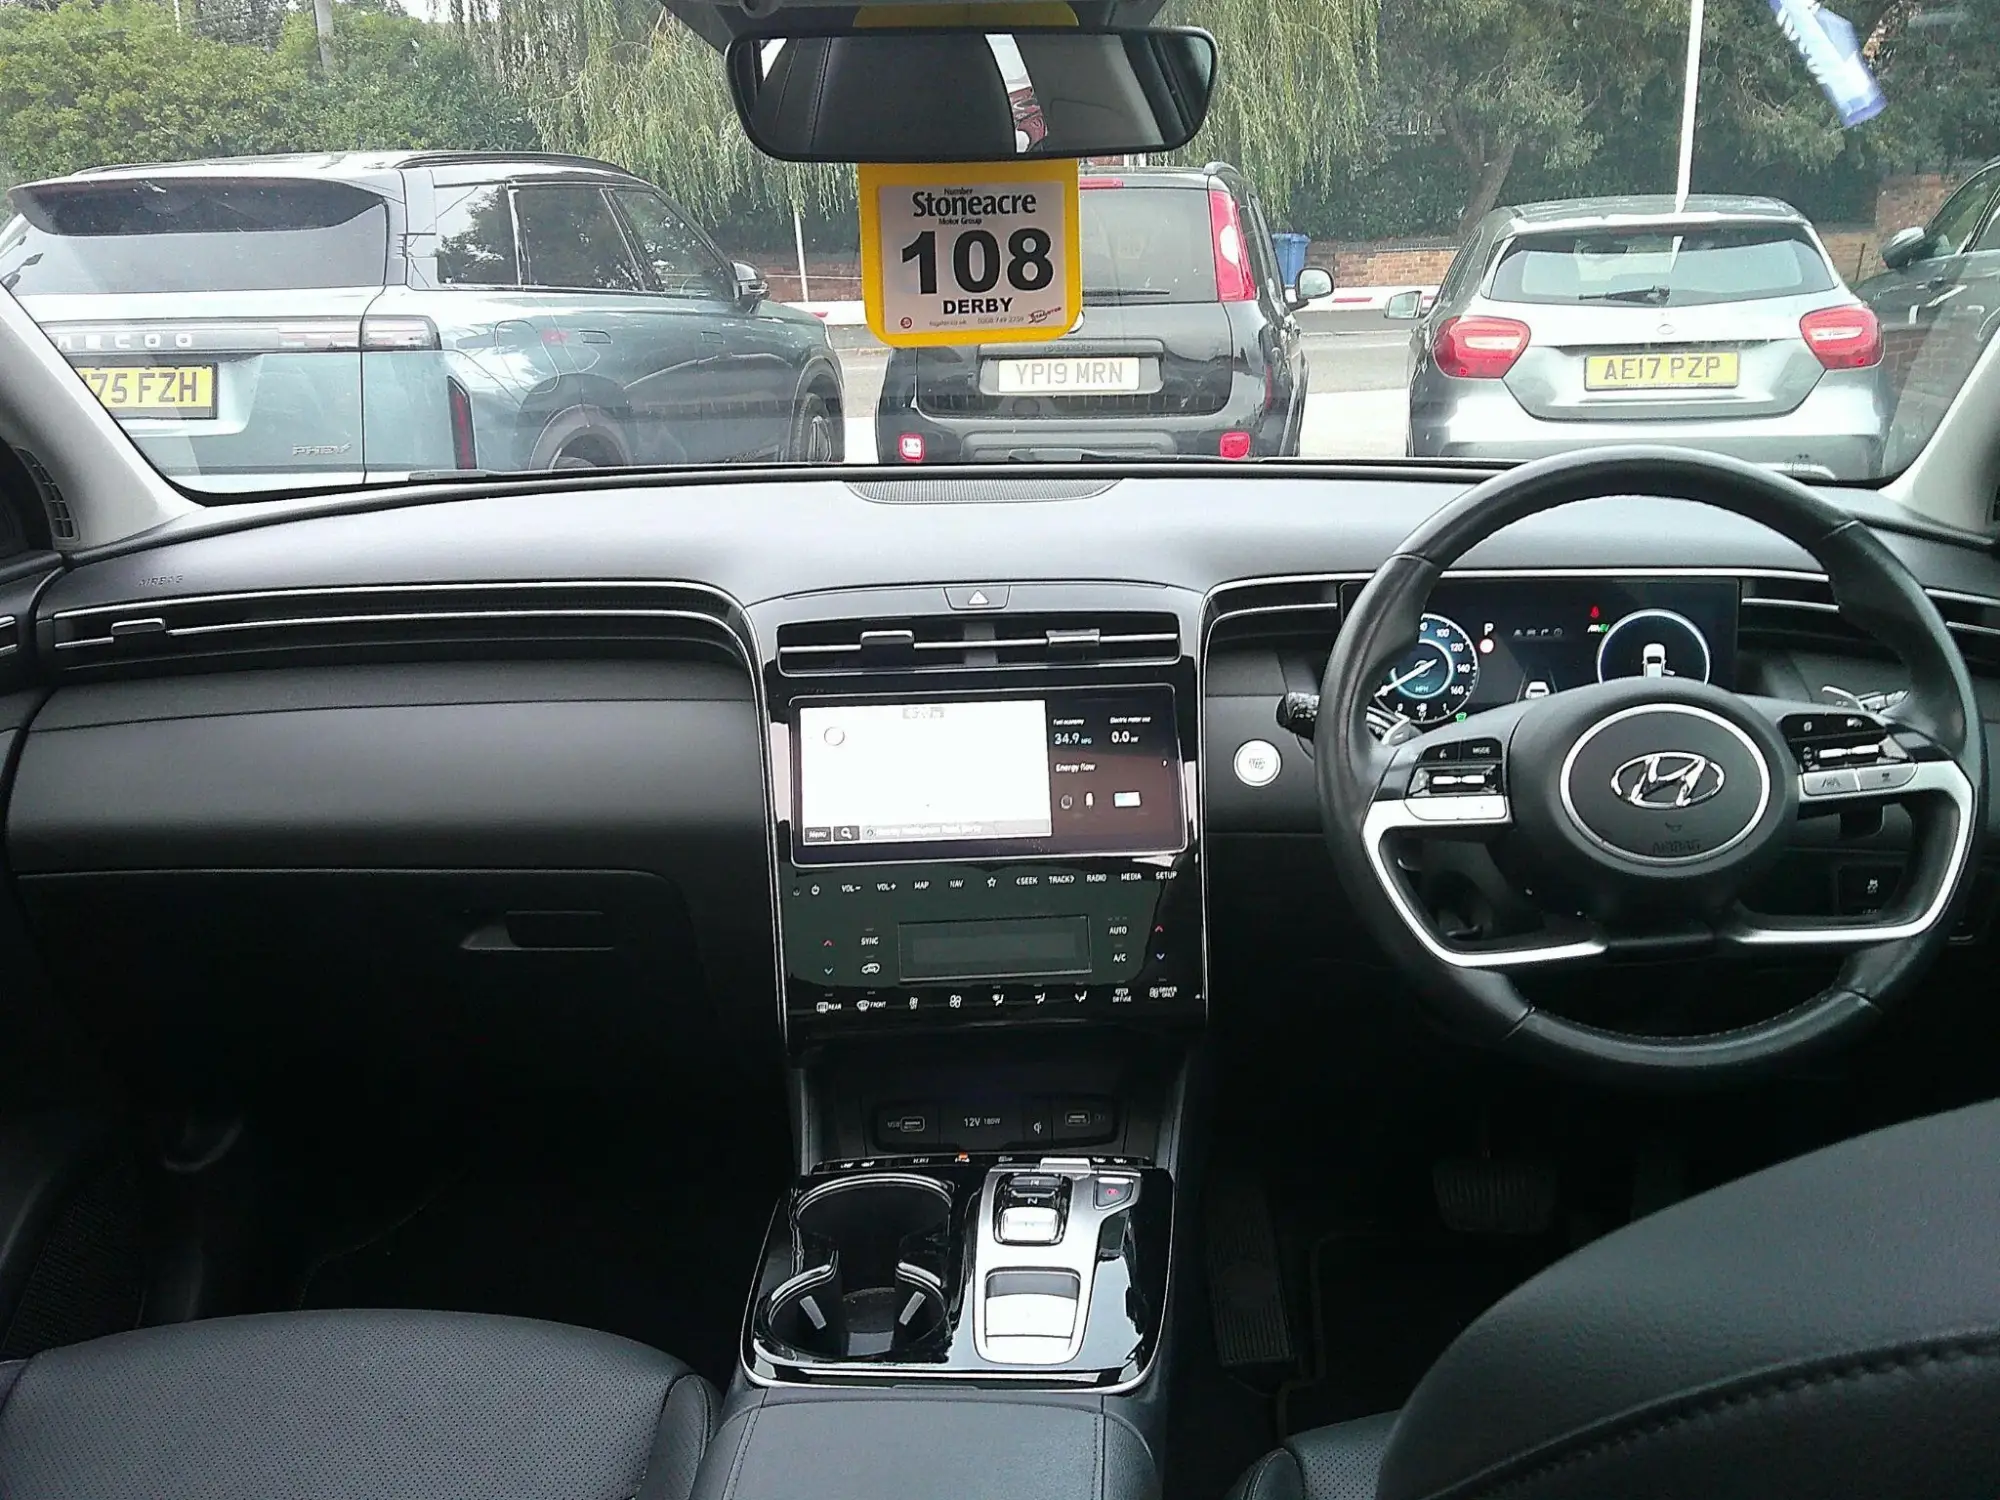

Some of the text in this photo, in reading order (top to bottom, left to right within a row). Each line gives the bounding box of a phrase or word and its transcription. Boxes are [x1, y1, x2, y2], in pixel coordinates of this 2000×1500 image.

[912, 191, 1037, 218] Stoneacre
[938, 216, 983, 228] Motor Group
[901, 228, 1054, 295] 108
[943, 297, 1013, 315] DERBY
[1015, 362, 1123, 386] YP19 MRN
[1604, 356, 1721, 381] AE17 PZP
[138, 371, 197, 404] FZH
[1436, 627, 1450, 639] 100
[1483, 622, 1494, 636] P
[1450, 642, 1464, 653] 120
[1456, 663, 1471, 674] 140
[1450, 685, 1464, 696] 160
[1054, 732, 1080, 745] 34.9
[1111, 730, 1130, 743] 0.0
[1055, 761, 1096, 774] Energy flow
[1086, 873, 1107, 883] RADIO
[1120, 873, 1142, 881] MEDIA
[1155, 870, 1178, 881] SETUP
[914, 881, 930, 891] MAP
[1108, 925, 1128, 935] AUTO
[860, 936, 880, 946] SYNC
[1112, 953, 1128, 963] A/C
[963, 1116, 981, 1128] 12V
